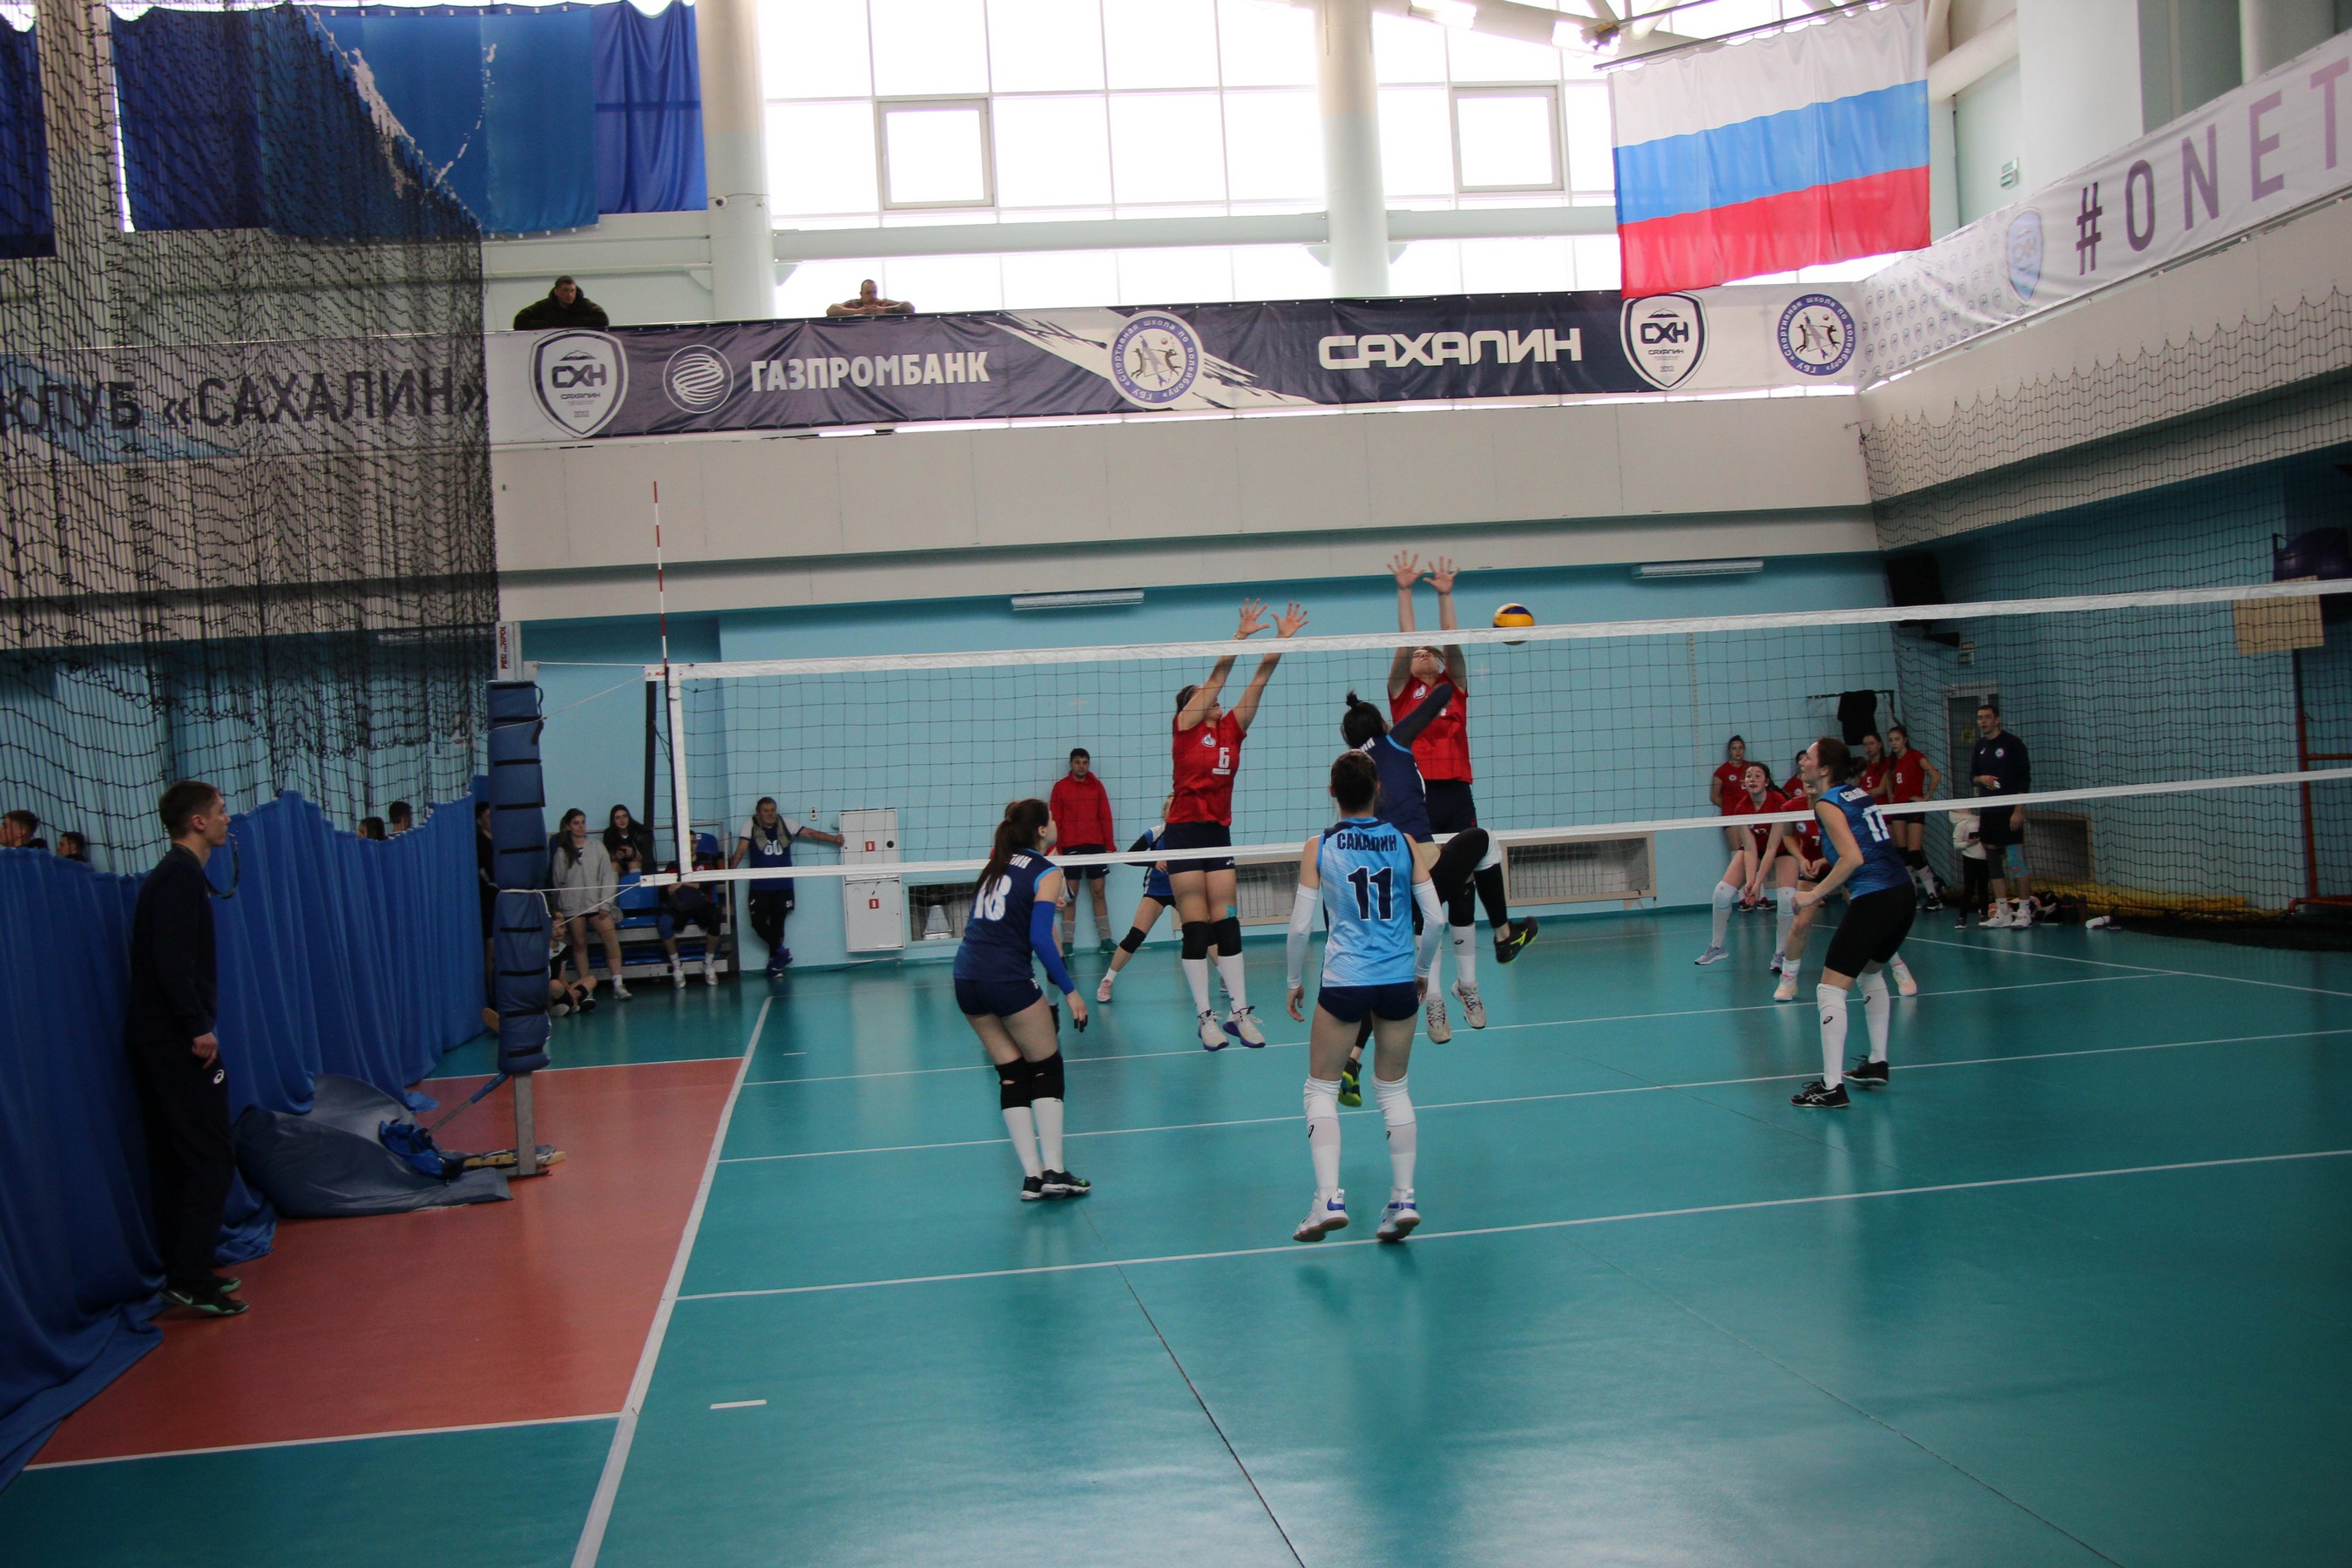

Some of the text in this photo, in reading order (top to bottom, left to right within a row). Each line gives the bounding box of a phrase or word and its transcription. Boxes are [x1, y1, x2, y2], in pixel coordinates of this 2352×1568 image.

[2076, 57, 2350, 276] #ONET
[1132, 389, 1153, 401] ГБУ
[1143, 320, 1176, 331] школа
[1178, 331, 1189, 343] по
[1318, 328, 1583, 370] САХАЛИН
[1796, 363, 1816, 373] ГБУ
[1806, 297, 1836, 308] школа
[1837, 308, 1848, 320] по
[163, 367, 489, 427] «САХАЛИН»
[751, 351, 990, 392] ГАЗПРОМБАНК
[1219, 747, 1230, 768] 6
[973, 874, 1012, 922] 18
[1347, 865, 1394, 921] 11
